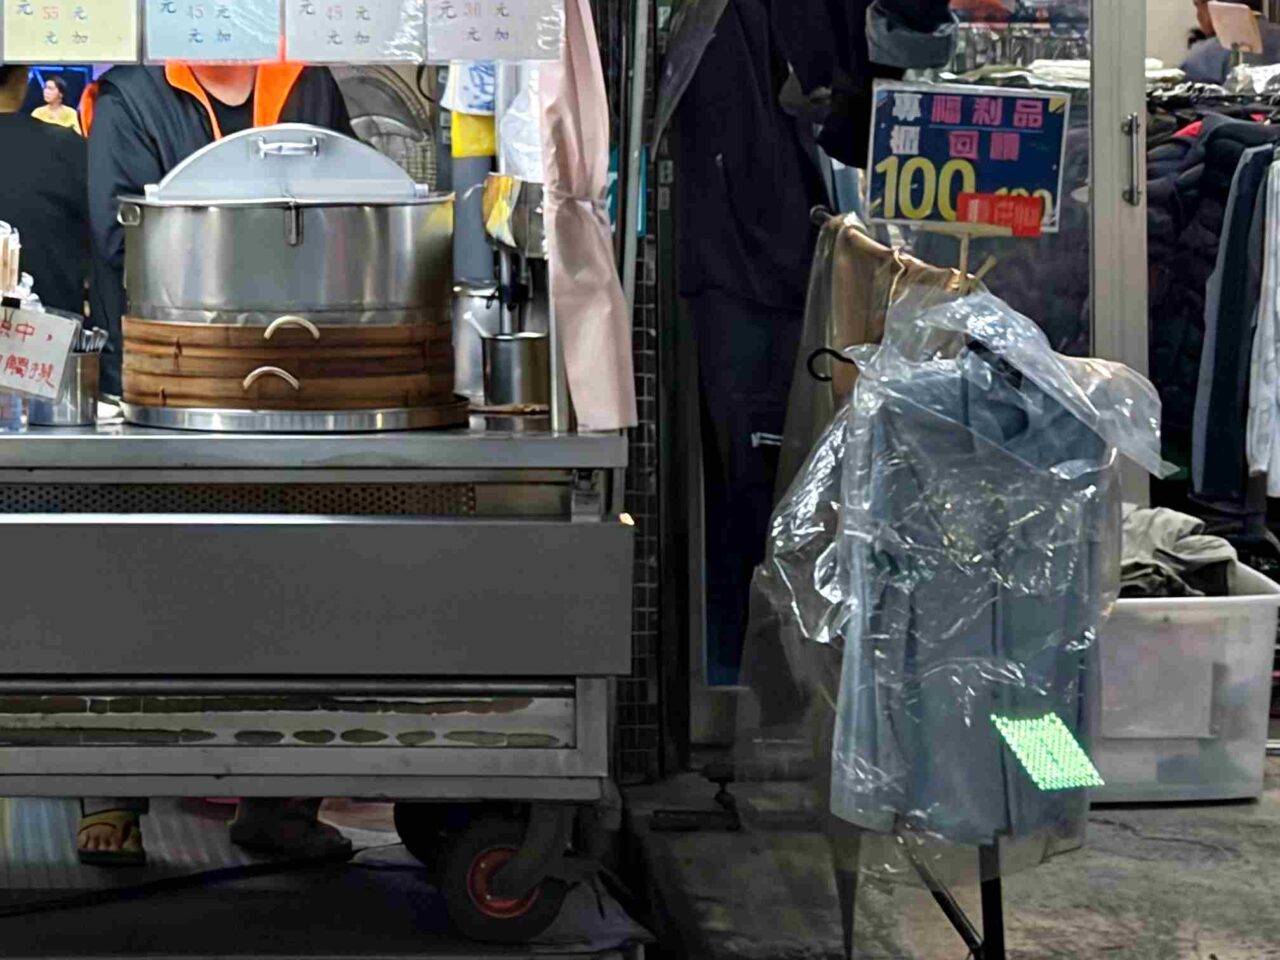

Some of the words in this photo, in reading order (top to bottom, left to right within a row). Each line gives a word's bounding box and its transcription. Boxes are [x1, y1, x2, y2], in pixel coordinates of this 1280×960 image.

[931, 96, 1044, 128] 福利品
[875, 156, 977, 221] 100
